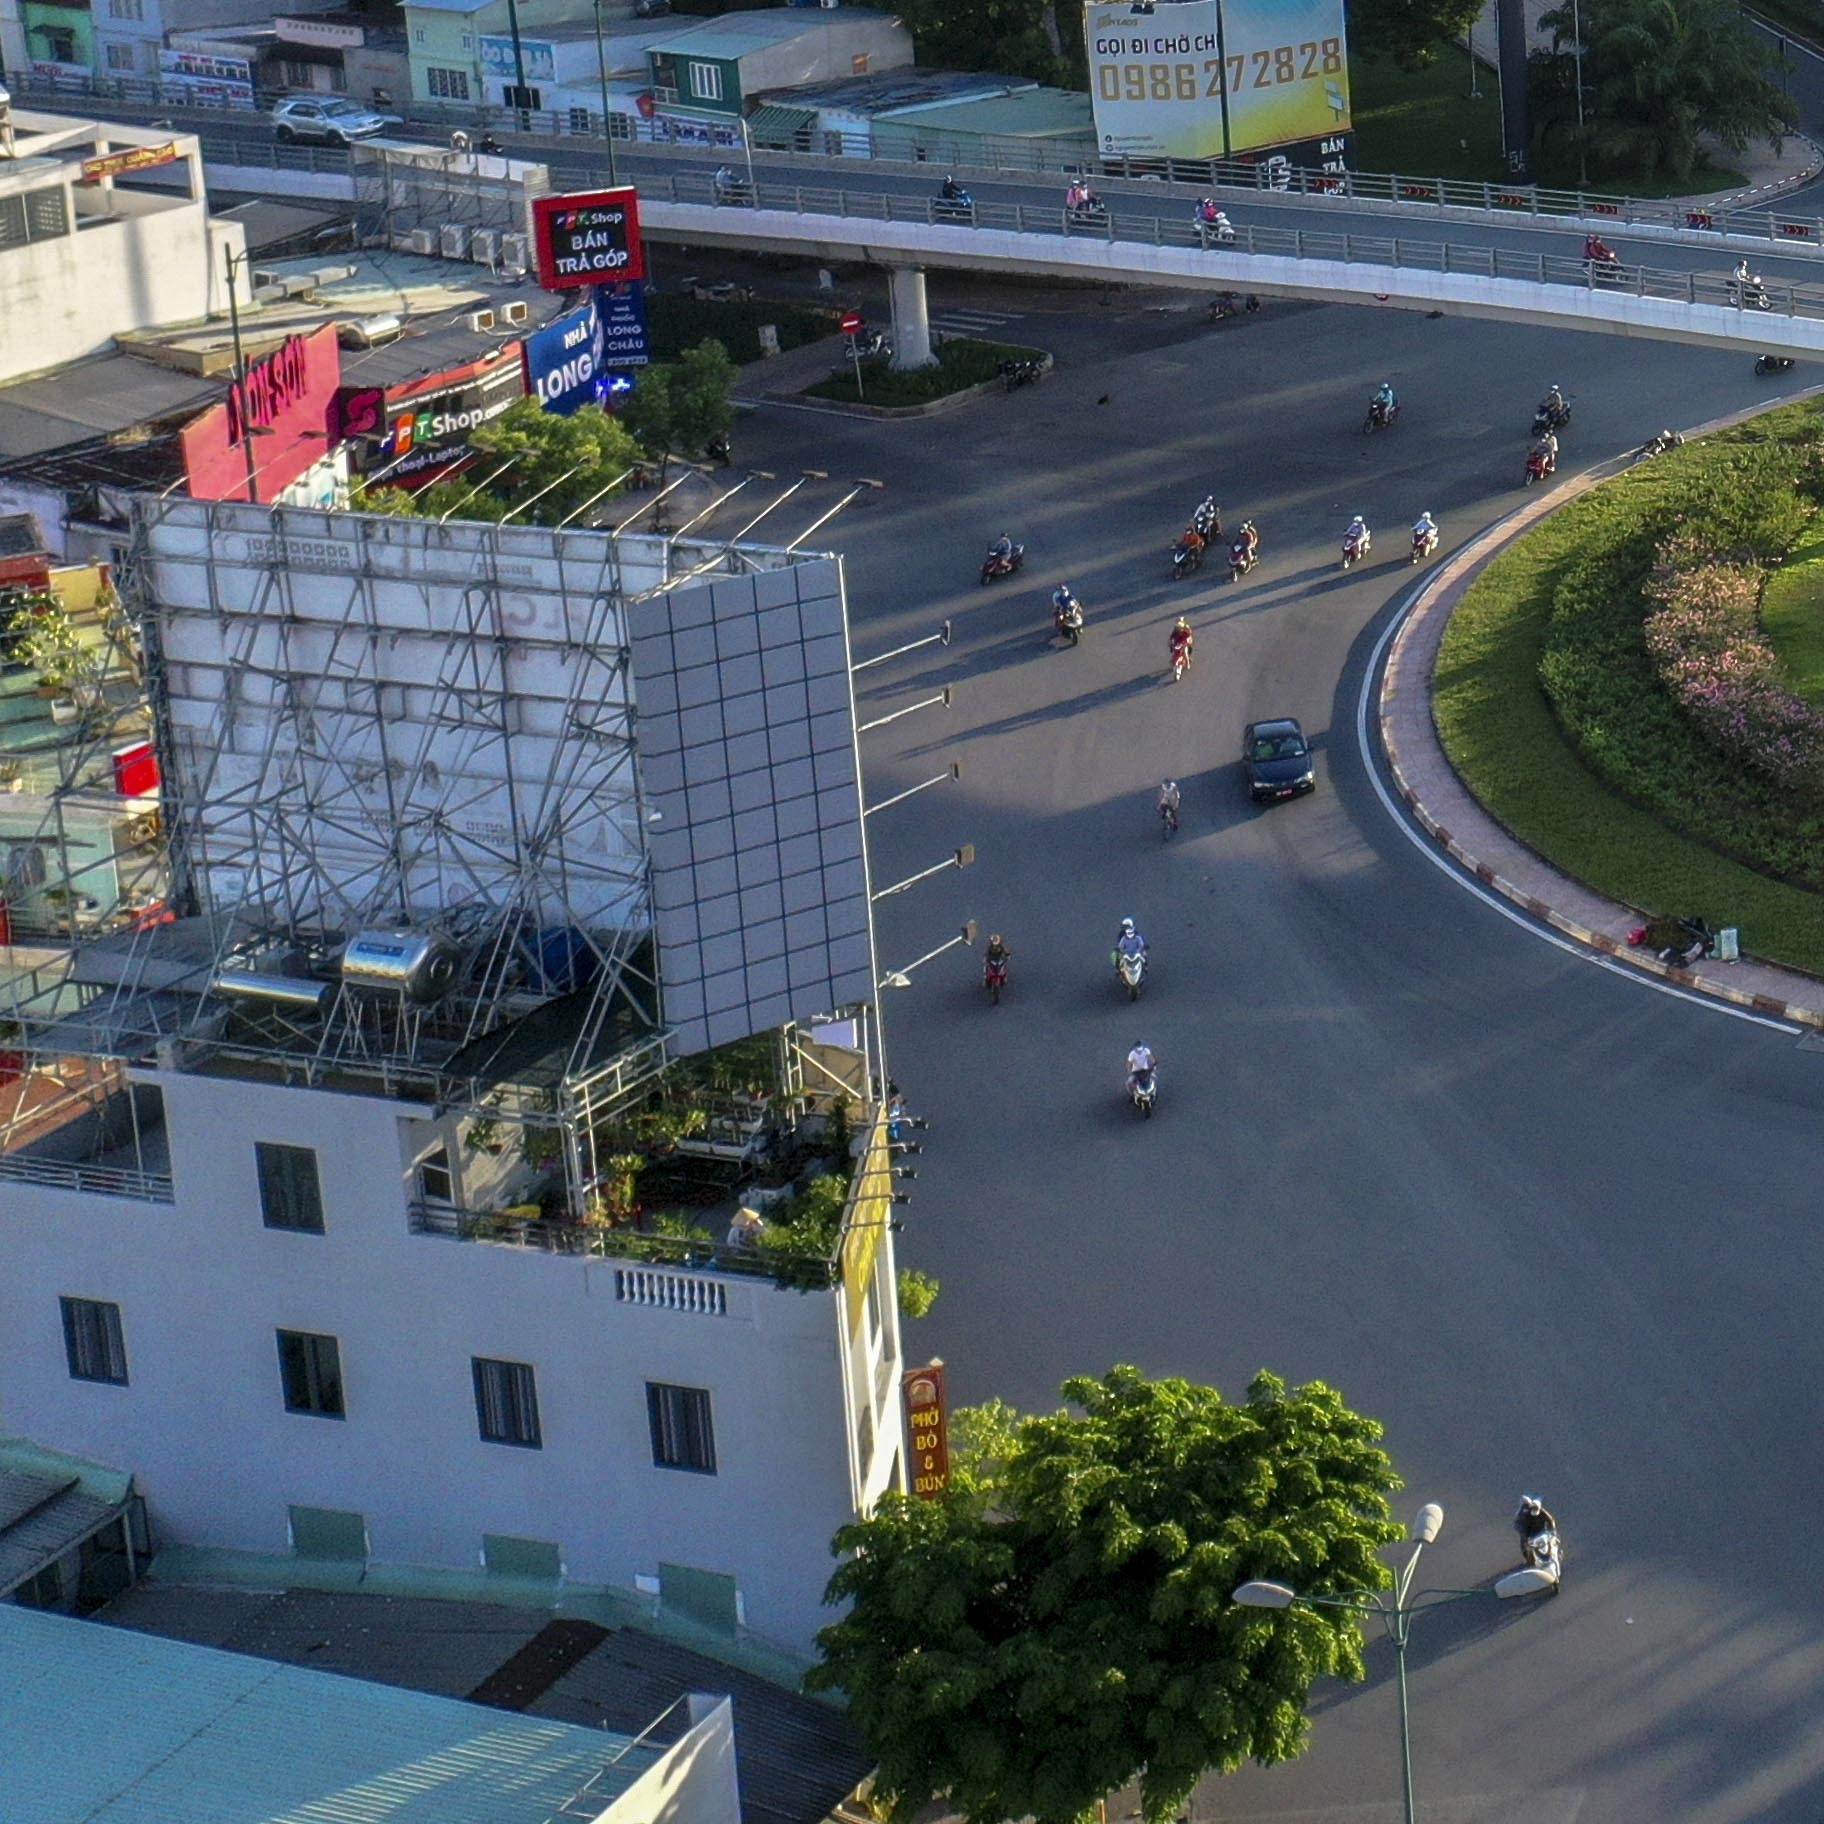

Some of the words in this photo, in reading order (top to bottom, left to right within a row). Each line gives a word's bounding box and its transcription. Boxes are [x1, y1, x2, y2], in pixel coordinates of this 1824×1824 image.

[1096, 38, 1125, 57] GỌI
[1131, 38, 1149, 54] ĐI
[1154, 34, 1190, 54] CHỜ
[1321, 137, 1345, 154] BÁN
[1322, 155, 1346, 175] TRẢ
[572, 231, 609, 251] BÁN
[556, 254, 592, 275] TRẢ
[593, 249, 629, 270] GÓP
[607, 324, 642, 336] LONG
[608, 338, 644, 351] CHÂU
[537, 353, 593, 406] LONG
[911, 1406, 939, 1428] PHỞ
[916, 1429, 938, 1450] BÒ
